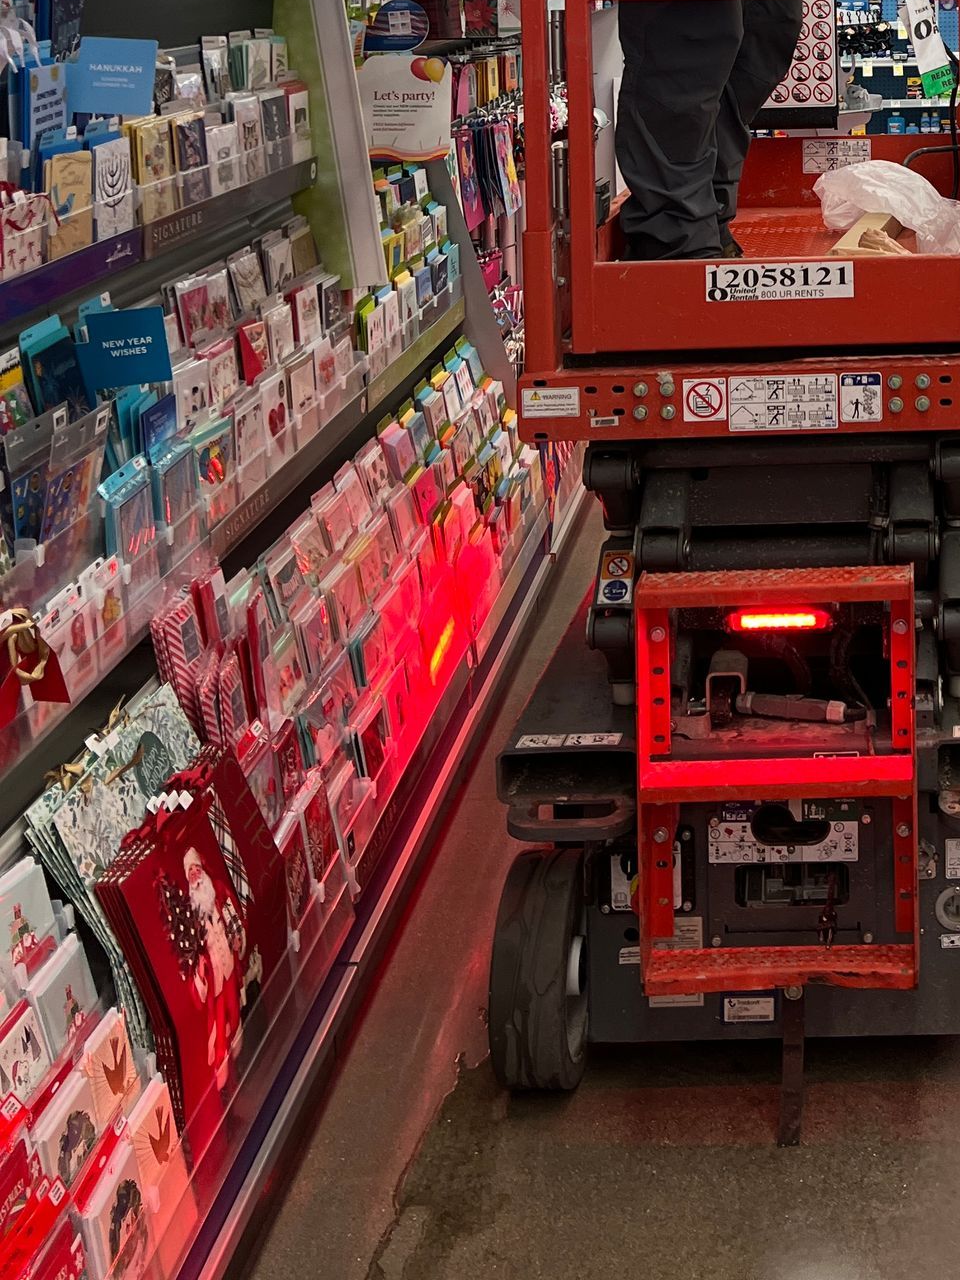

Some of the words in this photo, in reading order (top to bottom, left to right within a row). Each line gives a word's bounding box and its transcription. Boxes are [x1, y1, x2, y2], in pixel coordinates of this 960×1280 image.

[89, 63, 143, 74] HANUKKAH
[373, 90, 400, 101] Let’s
[402, 90, 436, 103] party!
[152, 210, 204, 243] SIGNATURE
[708, 265, 848, 289] 12058121
[729, 293, 759, 301] Rentals
[102, 339, 125, 349] NEW
[126, 335, 153, 346] YEAR
[110, 346, 148, 357] WISHES
